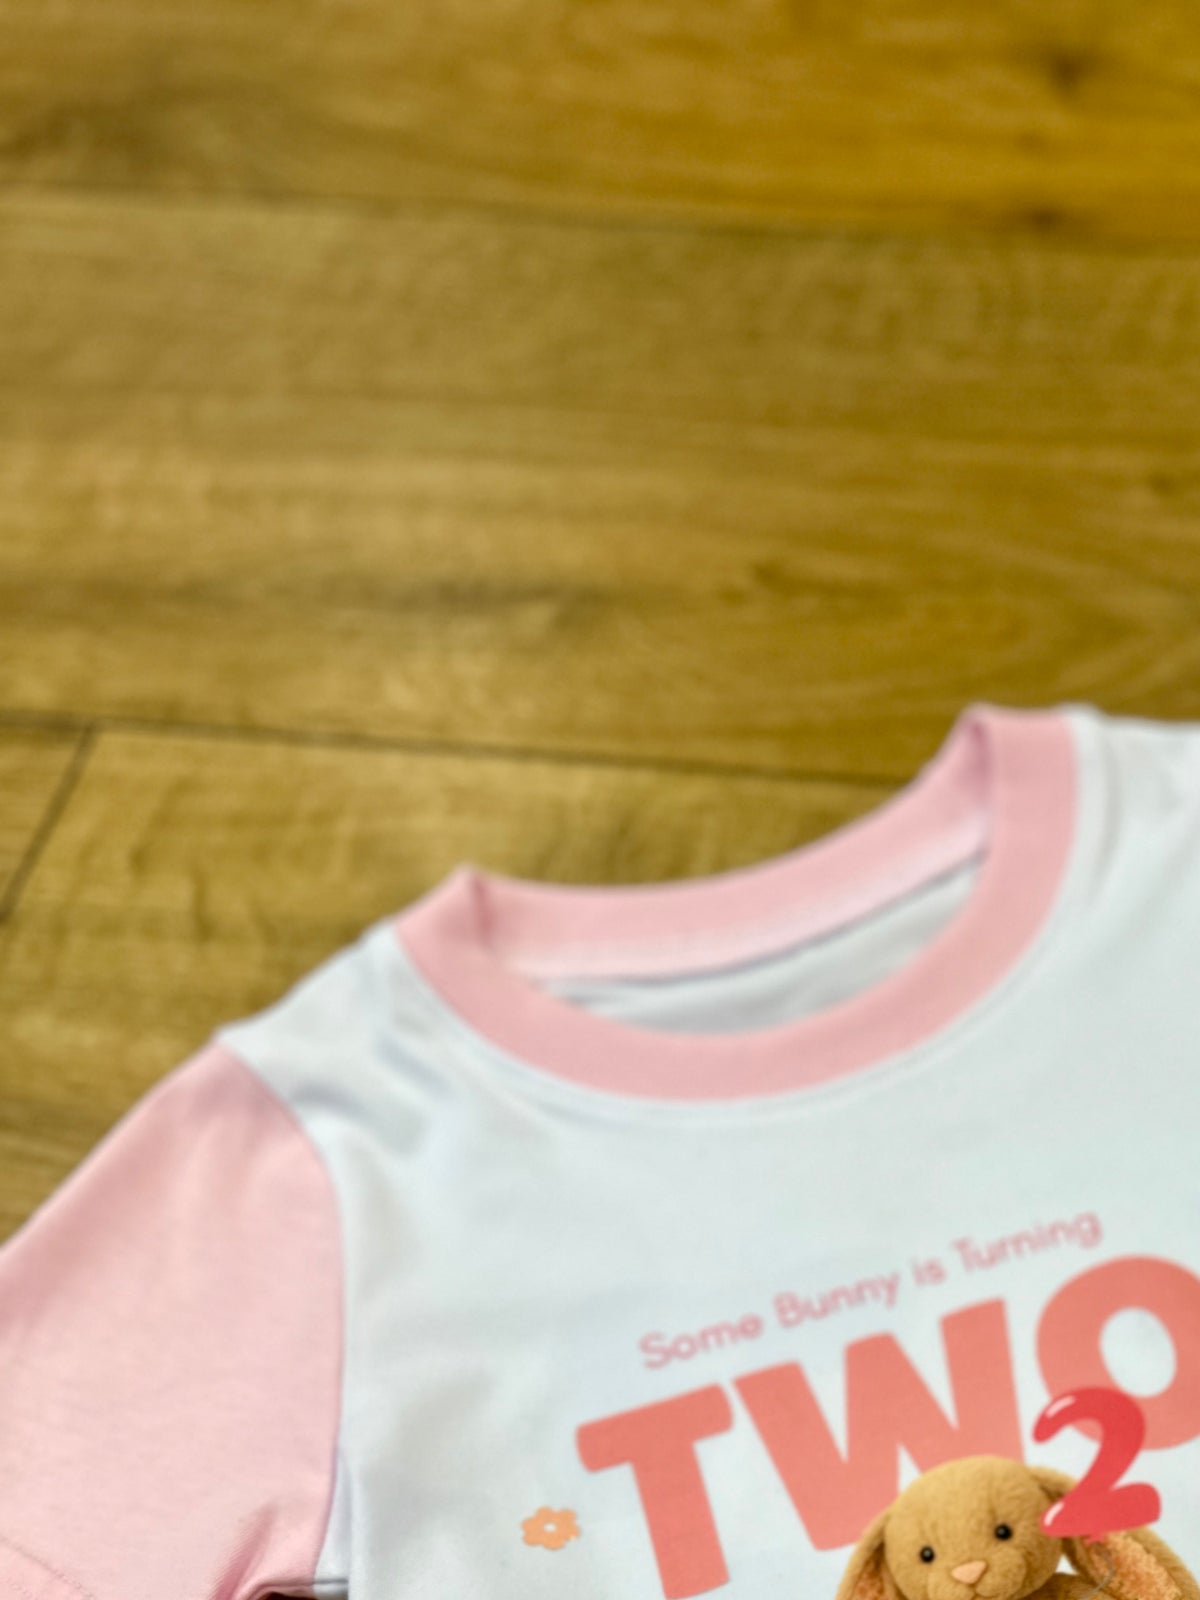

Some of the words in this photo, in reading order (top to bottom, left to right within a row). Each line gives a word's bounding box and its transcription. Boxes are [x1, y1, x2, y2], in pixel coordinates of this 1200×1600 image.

[637, 1311, 765, 1370] Some
[773, 1271, 903, 1328] Bunny
[912, 1254, 947, 1287] is
[952, 1210, 1104, 1275] Turning
[1032, 1386, 1162, 1538] 2
